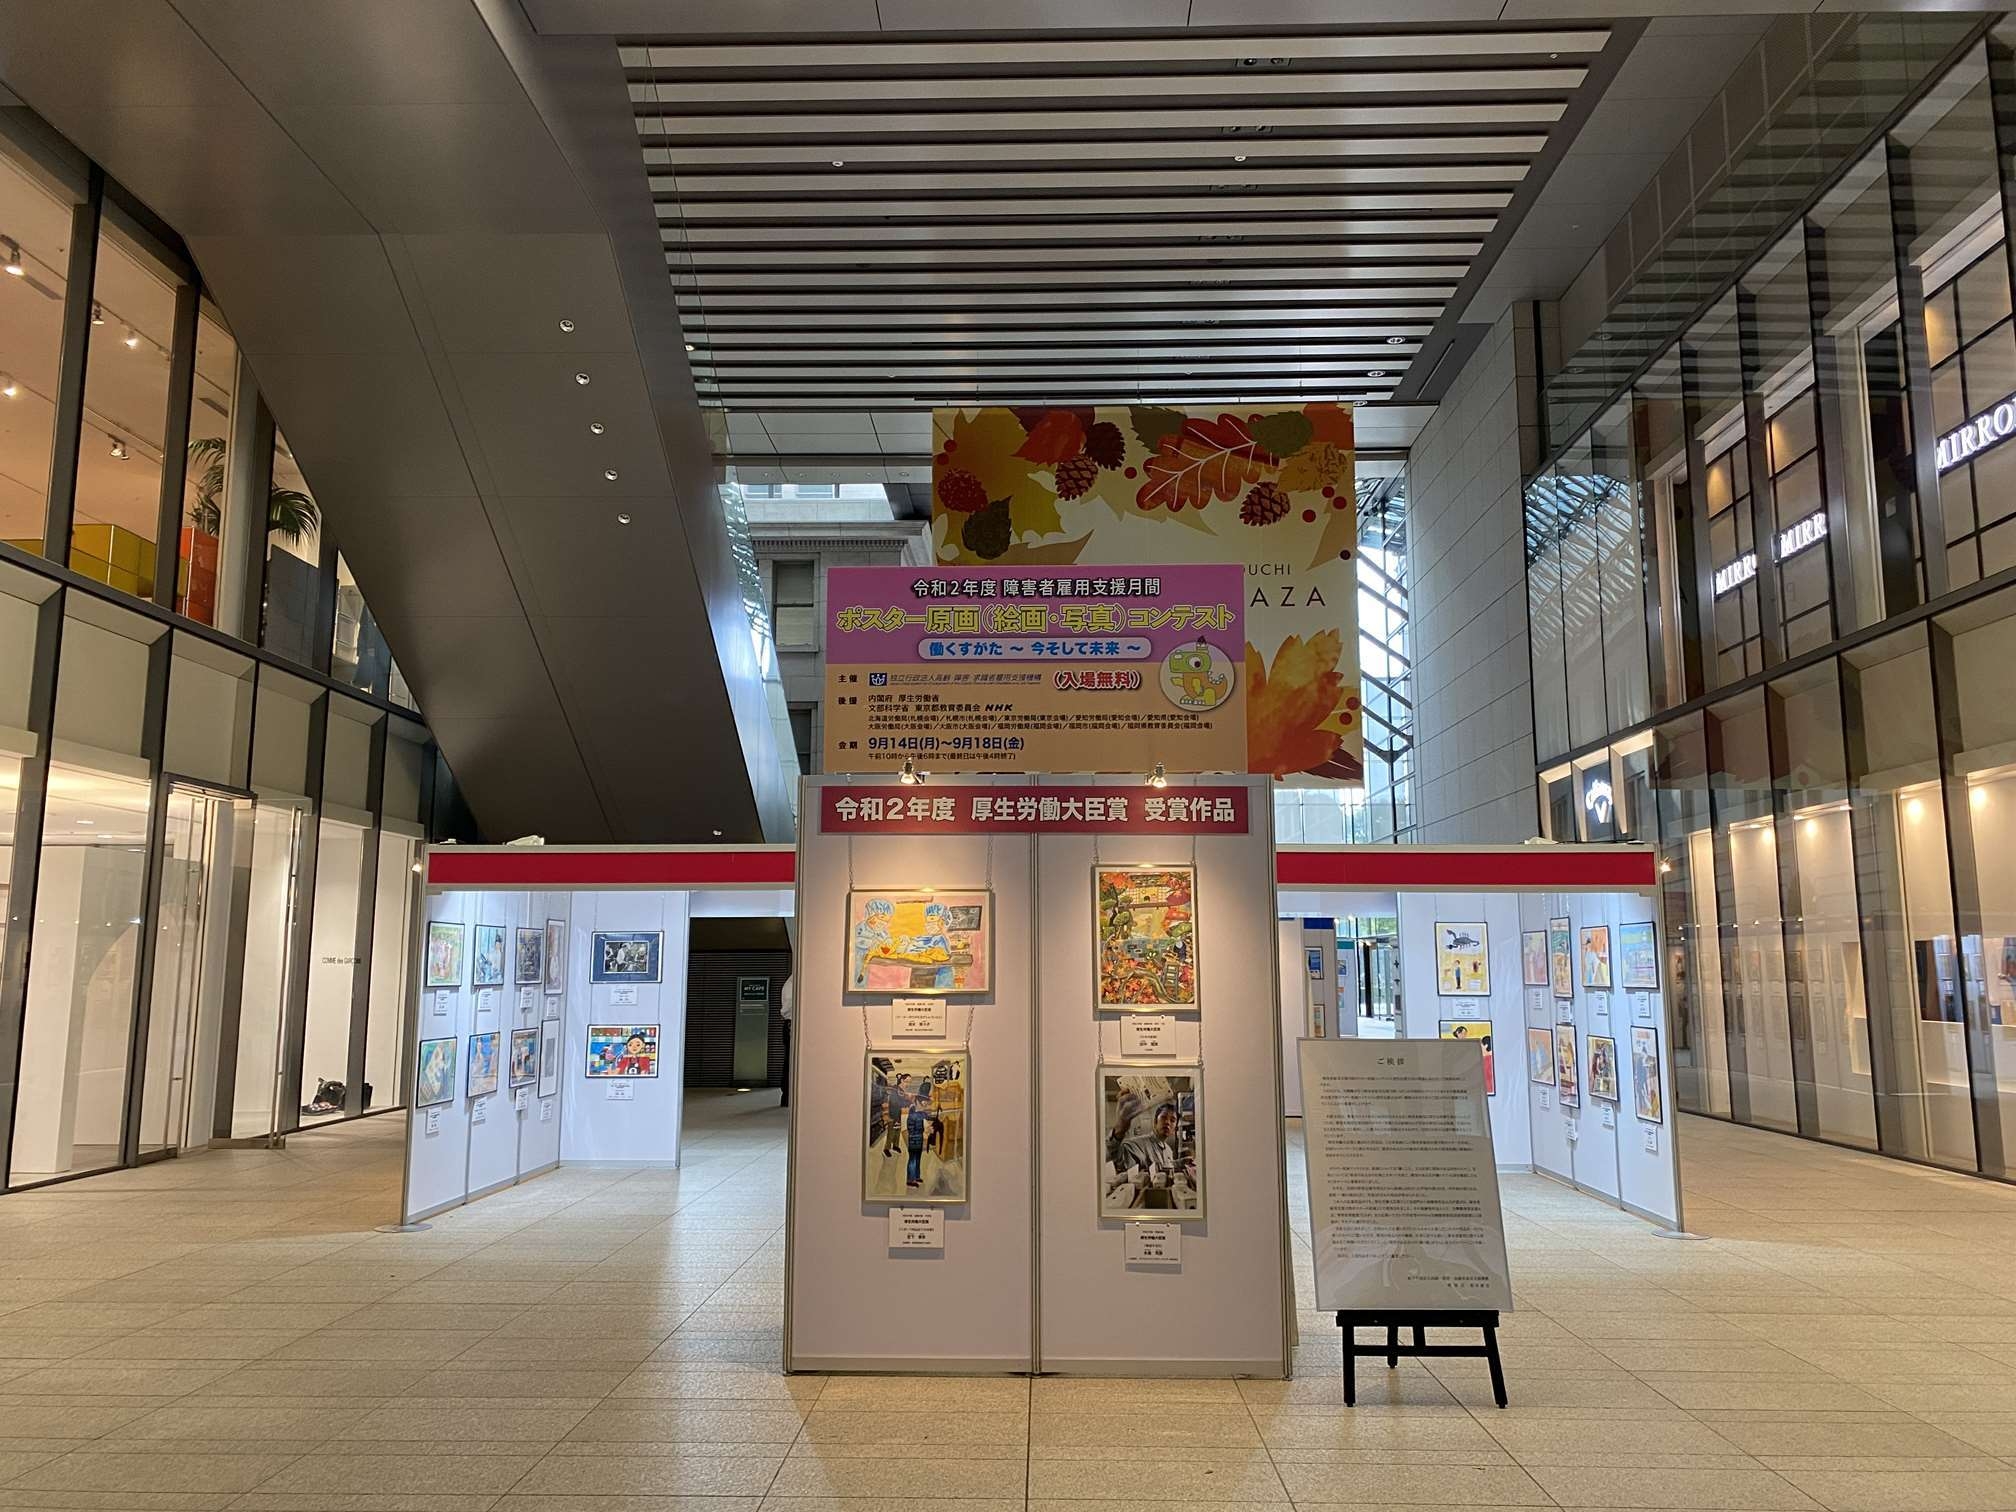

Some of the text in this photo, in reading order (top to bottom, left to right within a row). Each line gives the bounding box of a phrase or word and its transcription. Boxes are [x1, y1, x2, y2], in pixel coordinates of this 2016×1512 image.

[1243, 563, 1291, 576] UCHI
[913, 578, 1161, 597] 令和2年度 障害者雇用支援月間
[1249, 587, 1326, 607] AZA
[929, 641, 1003, 656] 働くすがた
[1031, 641, 1120, 656] 今そして未来
[985, 703, 1013, 712] NHK
[835, 796, 1235, 822] 令和2年度 厚生労働大臣賞 受賞作品
